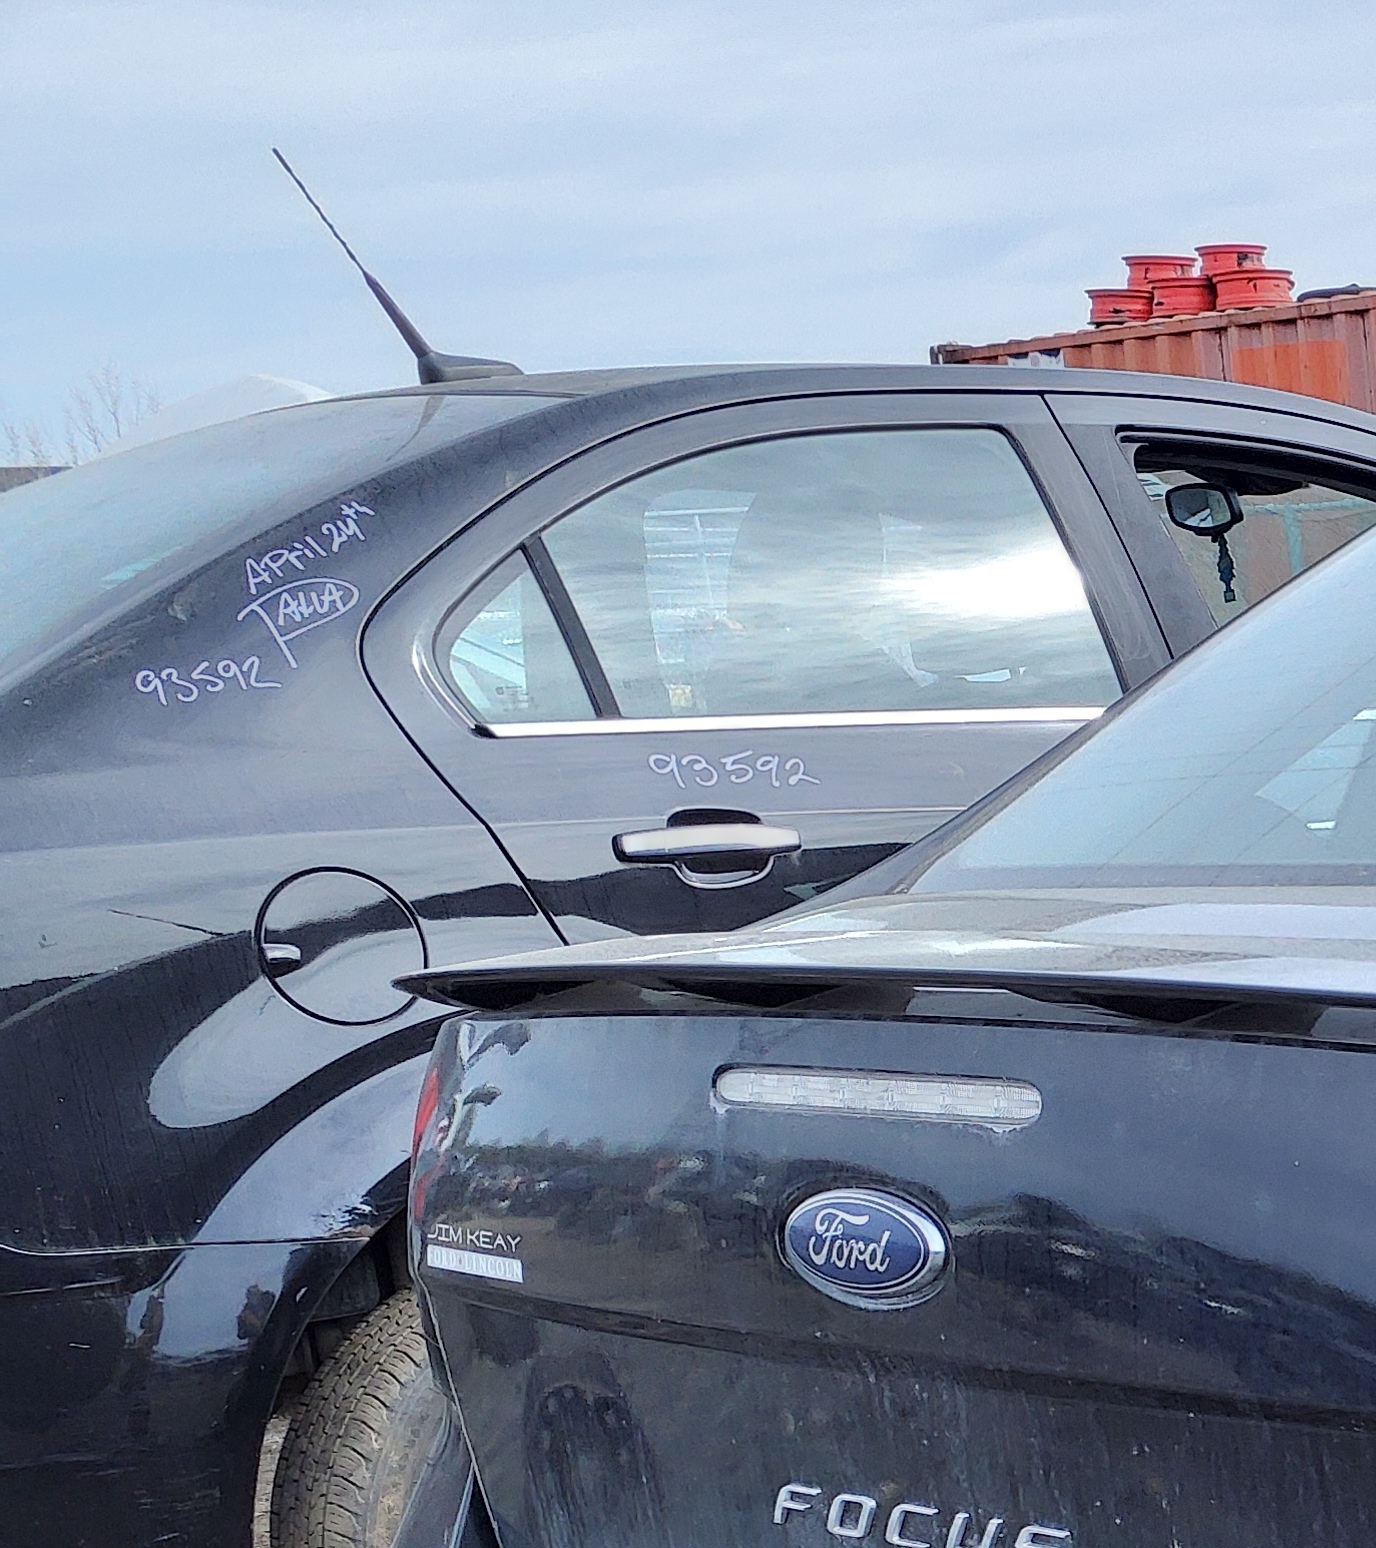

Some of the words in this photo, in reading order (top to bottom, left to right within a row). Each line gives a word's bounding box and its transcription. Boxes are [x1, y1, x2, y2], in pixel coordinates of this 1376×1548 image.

[134, 654, 283, 706] 93592
[647, 749, 821, 789] 93592
[427, 1223, 463, 1245] JIM
[466, 1227, 521, 1253] KEAY
[808, 1207, 891, 1273] Ford
[465, 1253, 523, 1281] LINCOLN
